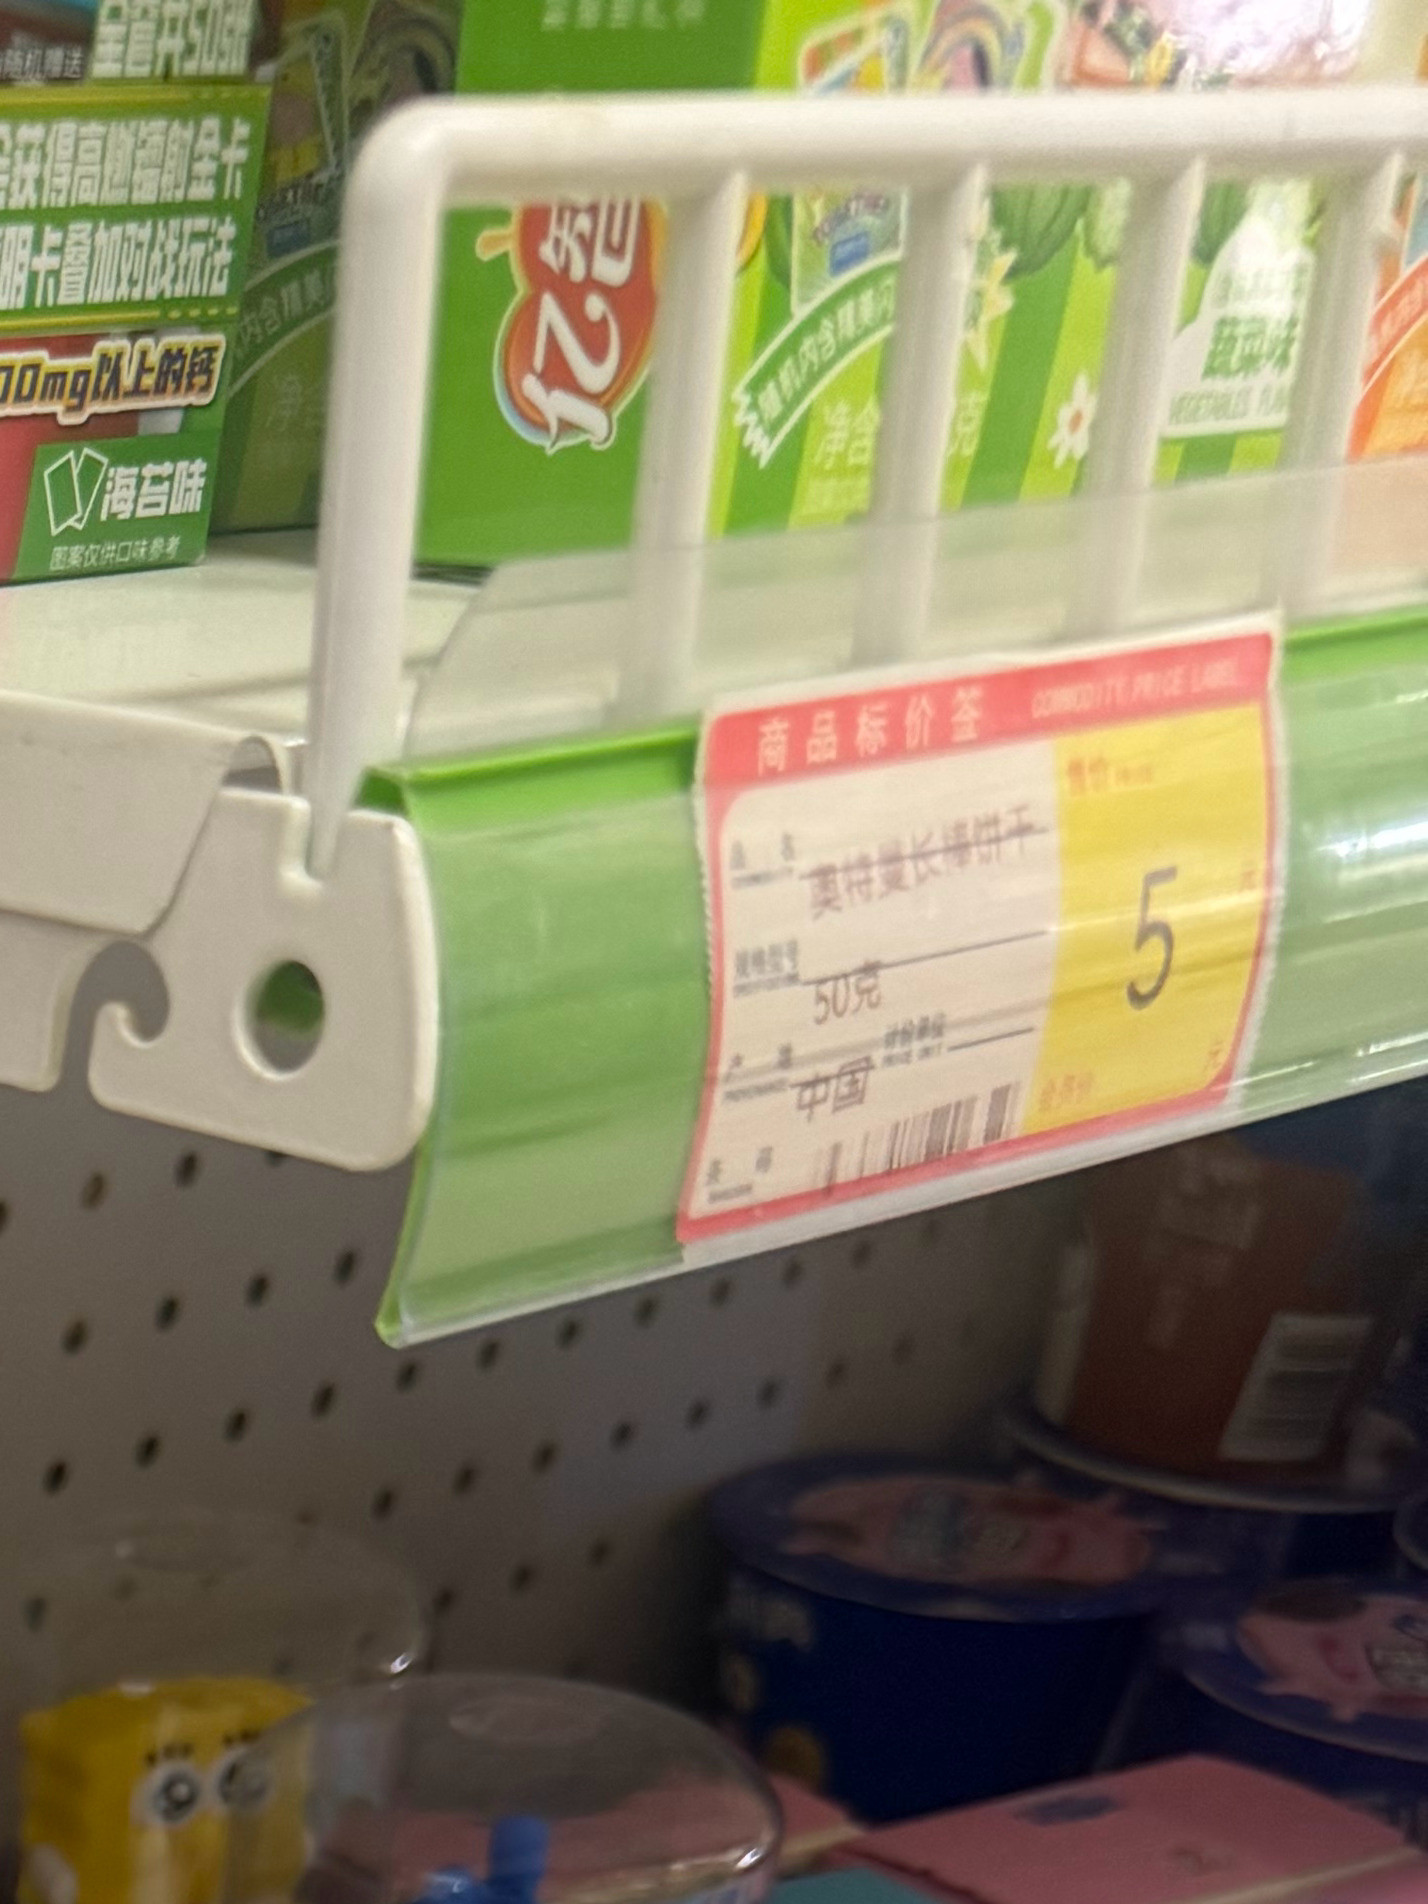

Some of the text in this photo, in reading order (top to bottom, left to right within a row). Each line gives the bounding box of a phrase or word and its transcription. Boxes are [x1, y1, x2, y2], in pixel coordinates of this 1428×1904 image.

[99, 457, 209, 523] 海苔味
[48, 534, 182, 574] 图案仅供口味参考
[757, 685, 984, 777] 商品标价签
[1126, 866, 1179, 1012] 5
[813, 959, 883, 1026] 50克
[796, 1054, 875, 1123] 中国
